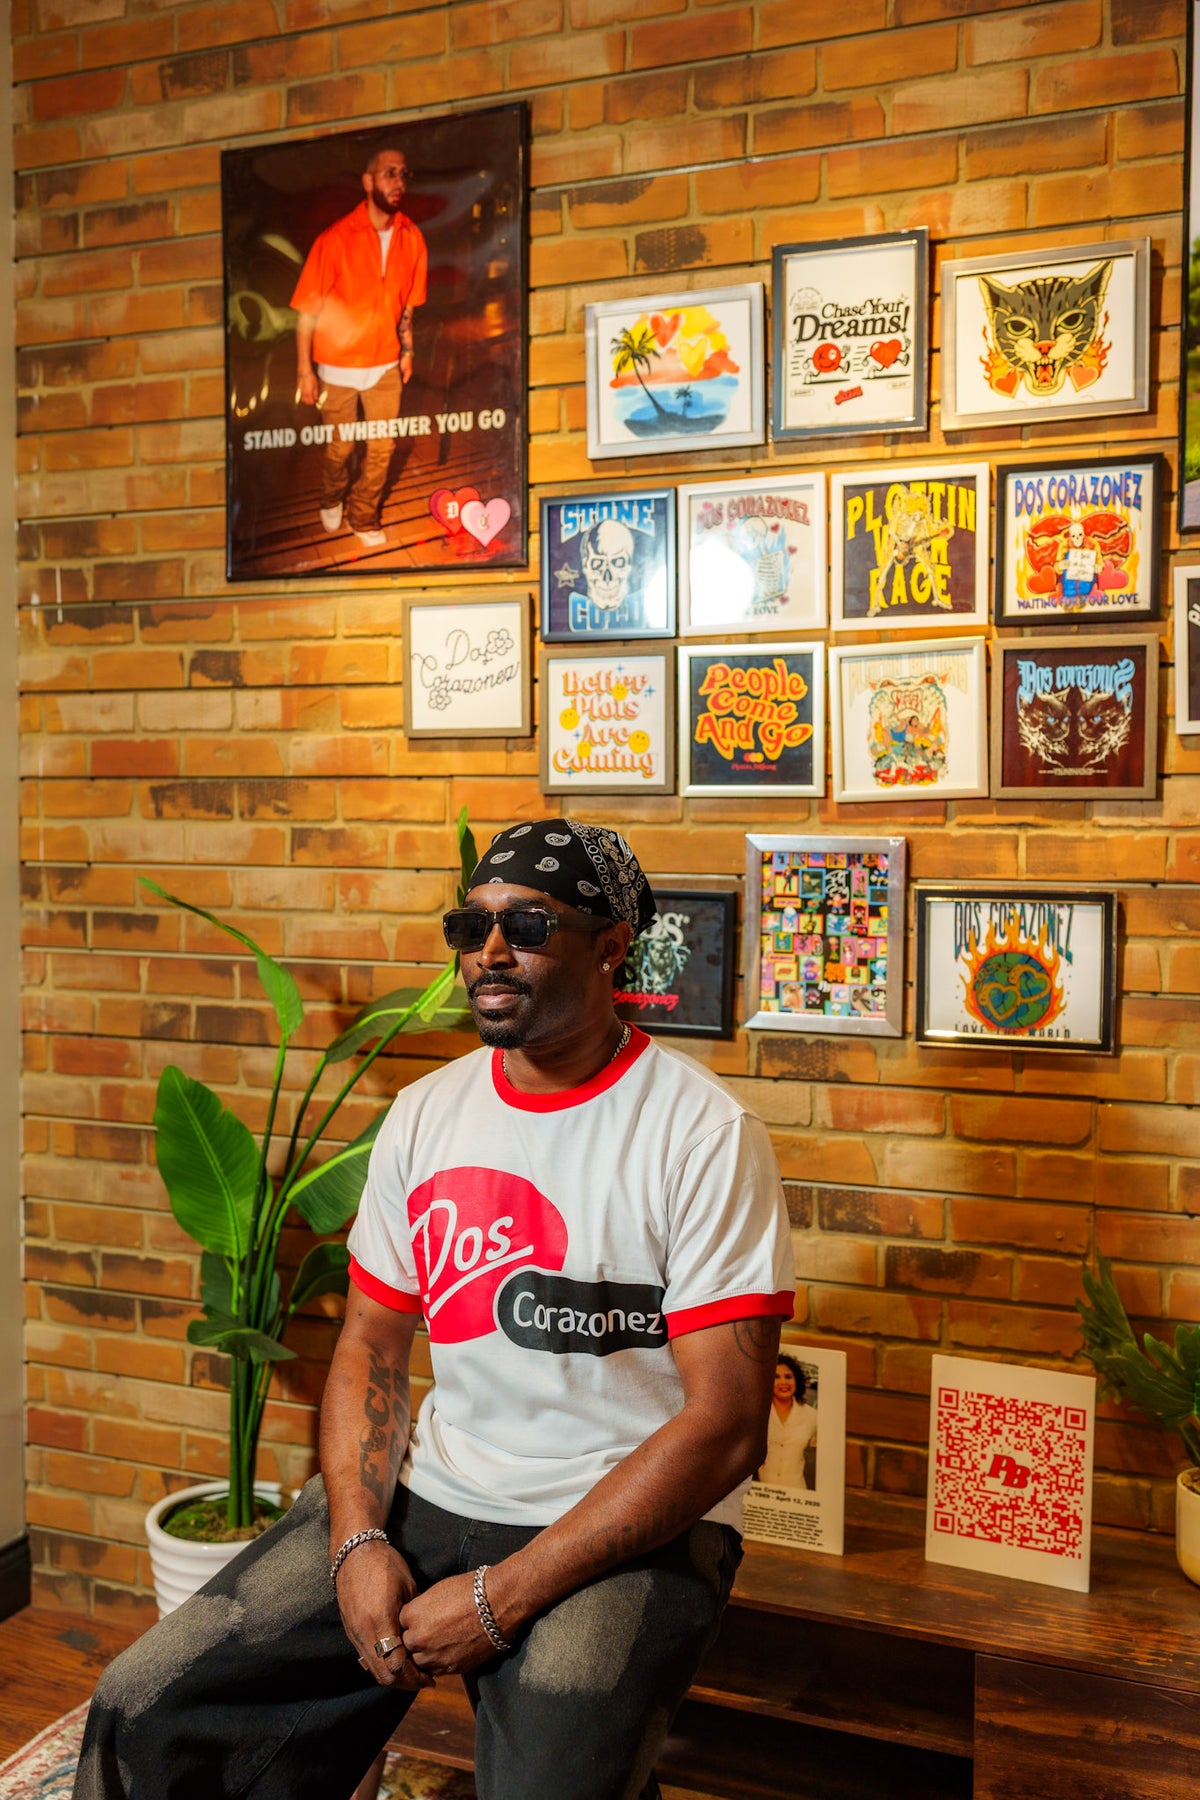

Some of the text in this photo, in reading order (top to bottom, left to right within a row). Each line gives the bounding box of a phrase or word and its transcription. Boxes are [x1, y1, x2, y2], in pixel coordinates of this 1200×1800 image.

[793, 305, 910, 343] Dreams!
[822, 298, 905, 319] Chase Your
[244, 409, 506, 450] STAND OUT WHEREVER YOU GO
[1015, 471, 1143, 517] DOS CORAZONEZ
[869, 563, 952, 609] RAGE
[1112, 591, 1140, 605] LOVE
[699, 658, 808, 702] People
[707, 687, 798, 724] Come
[695, 712, 755, 760] And
[410, 1199, 514, 1304] Dos
[512, 1291, 664, 1337] Corazonez
[987, 1453, 1032, 1490] PB
